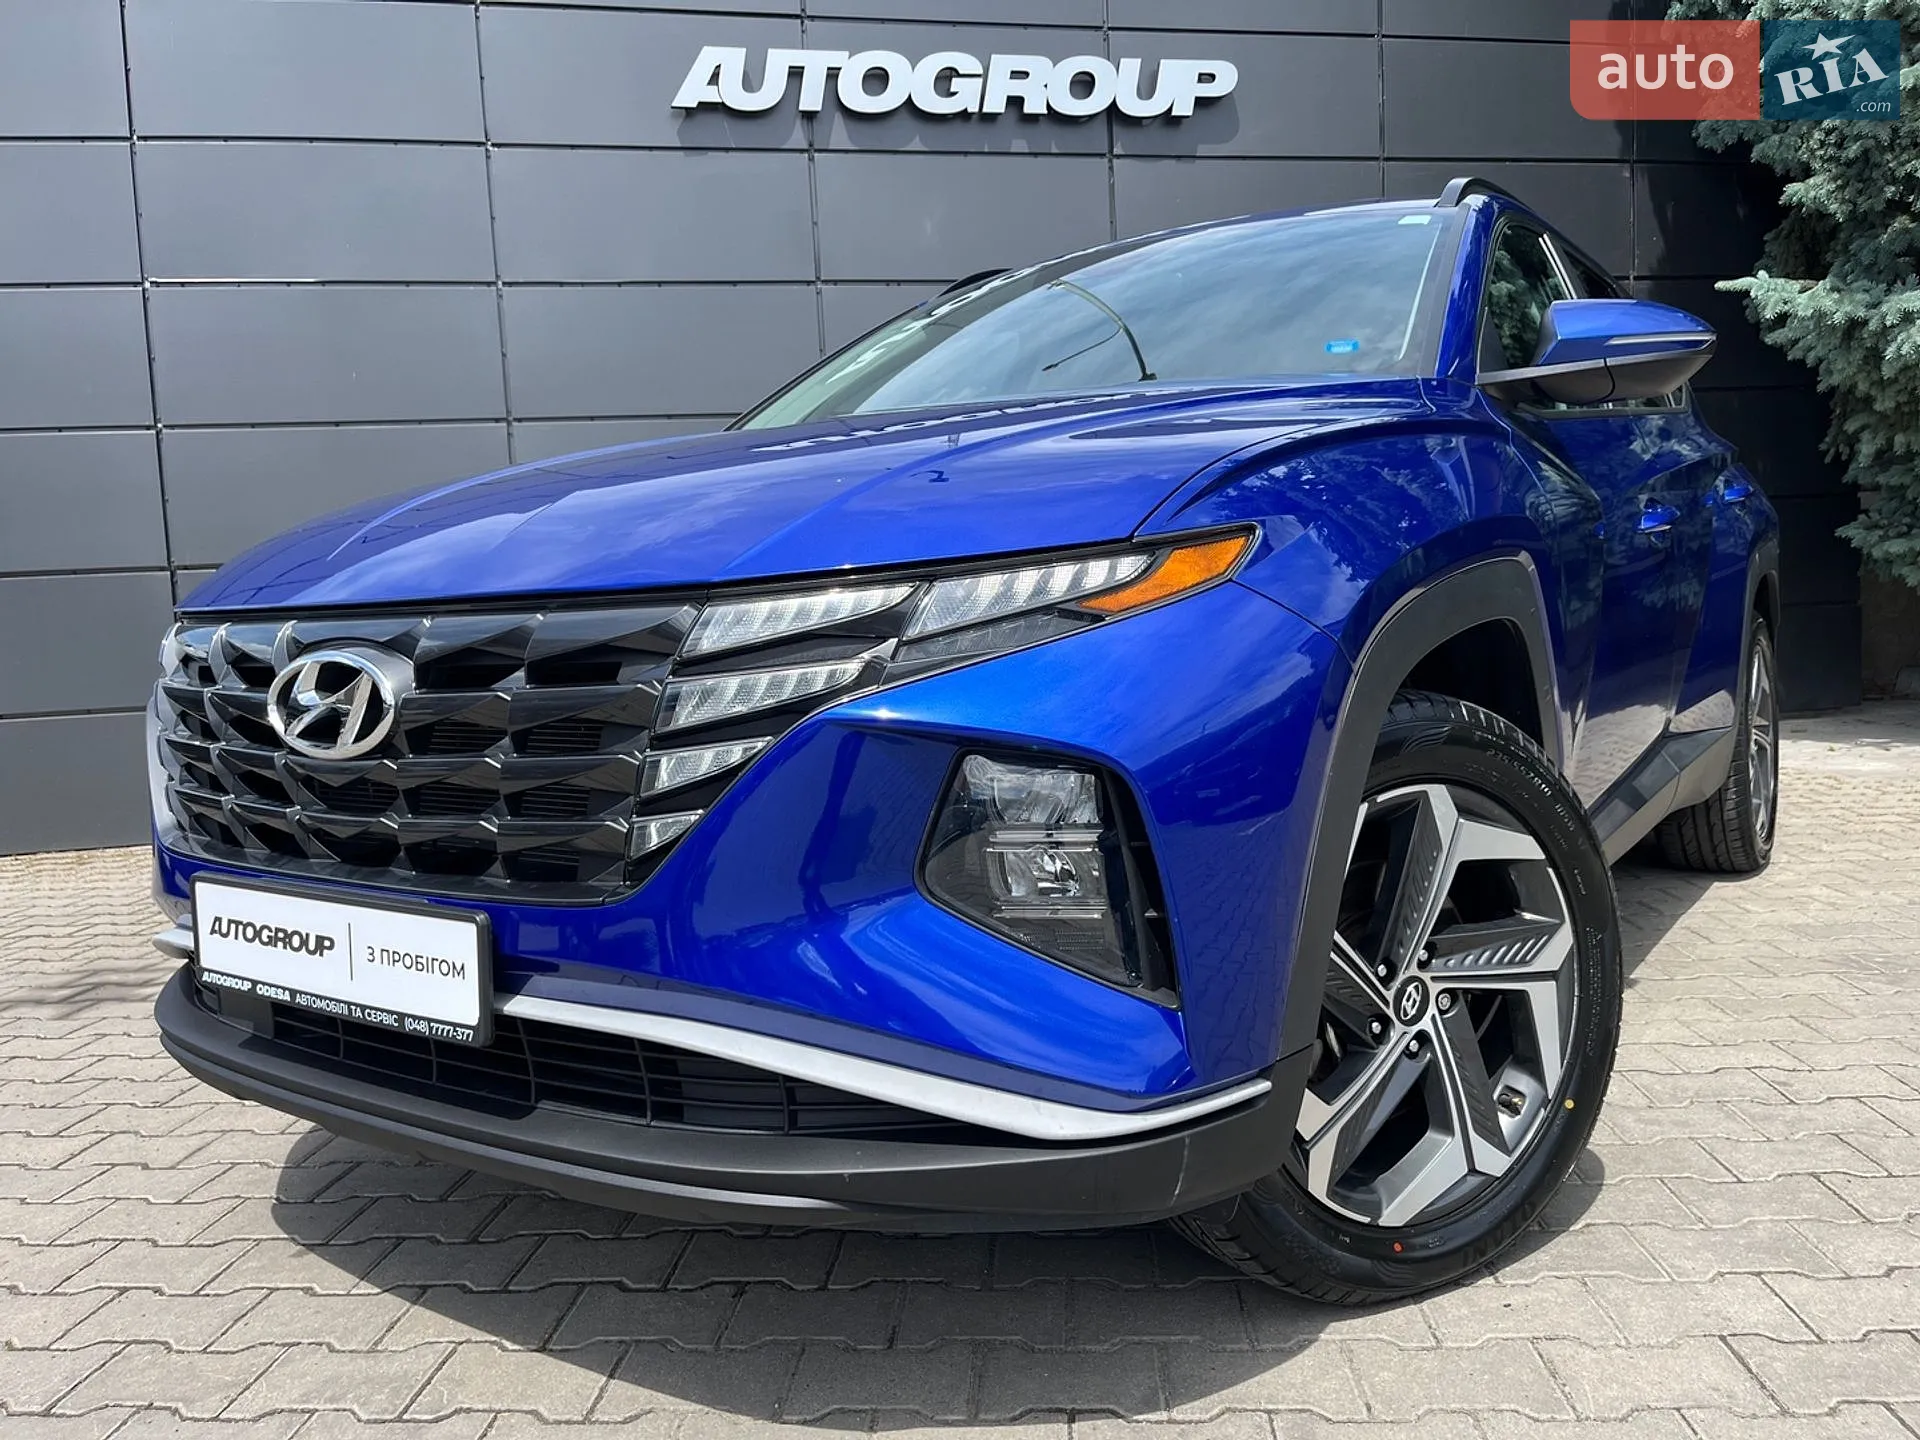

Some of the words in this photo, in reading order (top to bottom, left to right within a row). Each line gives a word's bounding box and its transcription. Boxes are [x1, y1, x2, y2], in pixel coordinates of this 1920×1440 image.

[671, 46, 1239, 117] AUTOGROUP
[209, 916, 336, 957] AUTOGROUP
[367, 946, 376, 963] З
[380, 948, 466, 981] ПРОБІГОМ
[202, 971, 252, 991] AUTOGROUP
[256, 984, 291, 1001] ODESA
[295, 993, 349, 1016] АВТОМОБІЛІ
[351, 1005, 363, 1018] ТА
[364, 1009, 399, 1027] СЕРВІС
[404, 1016, 430, 1035] (048)
[430, 1022, 474, 1042] 7777-377
